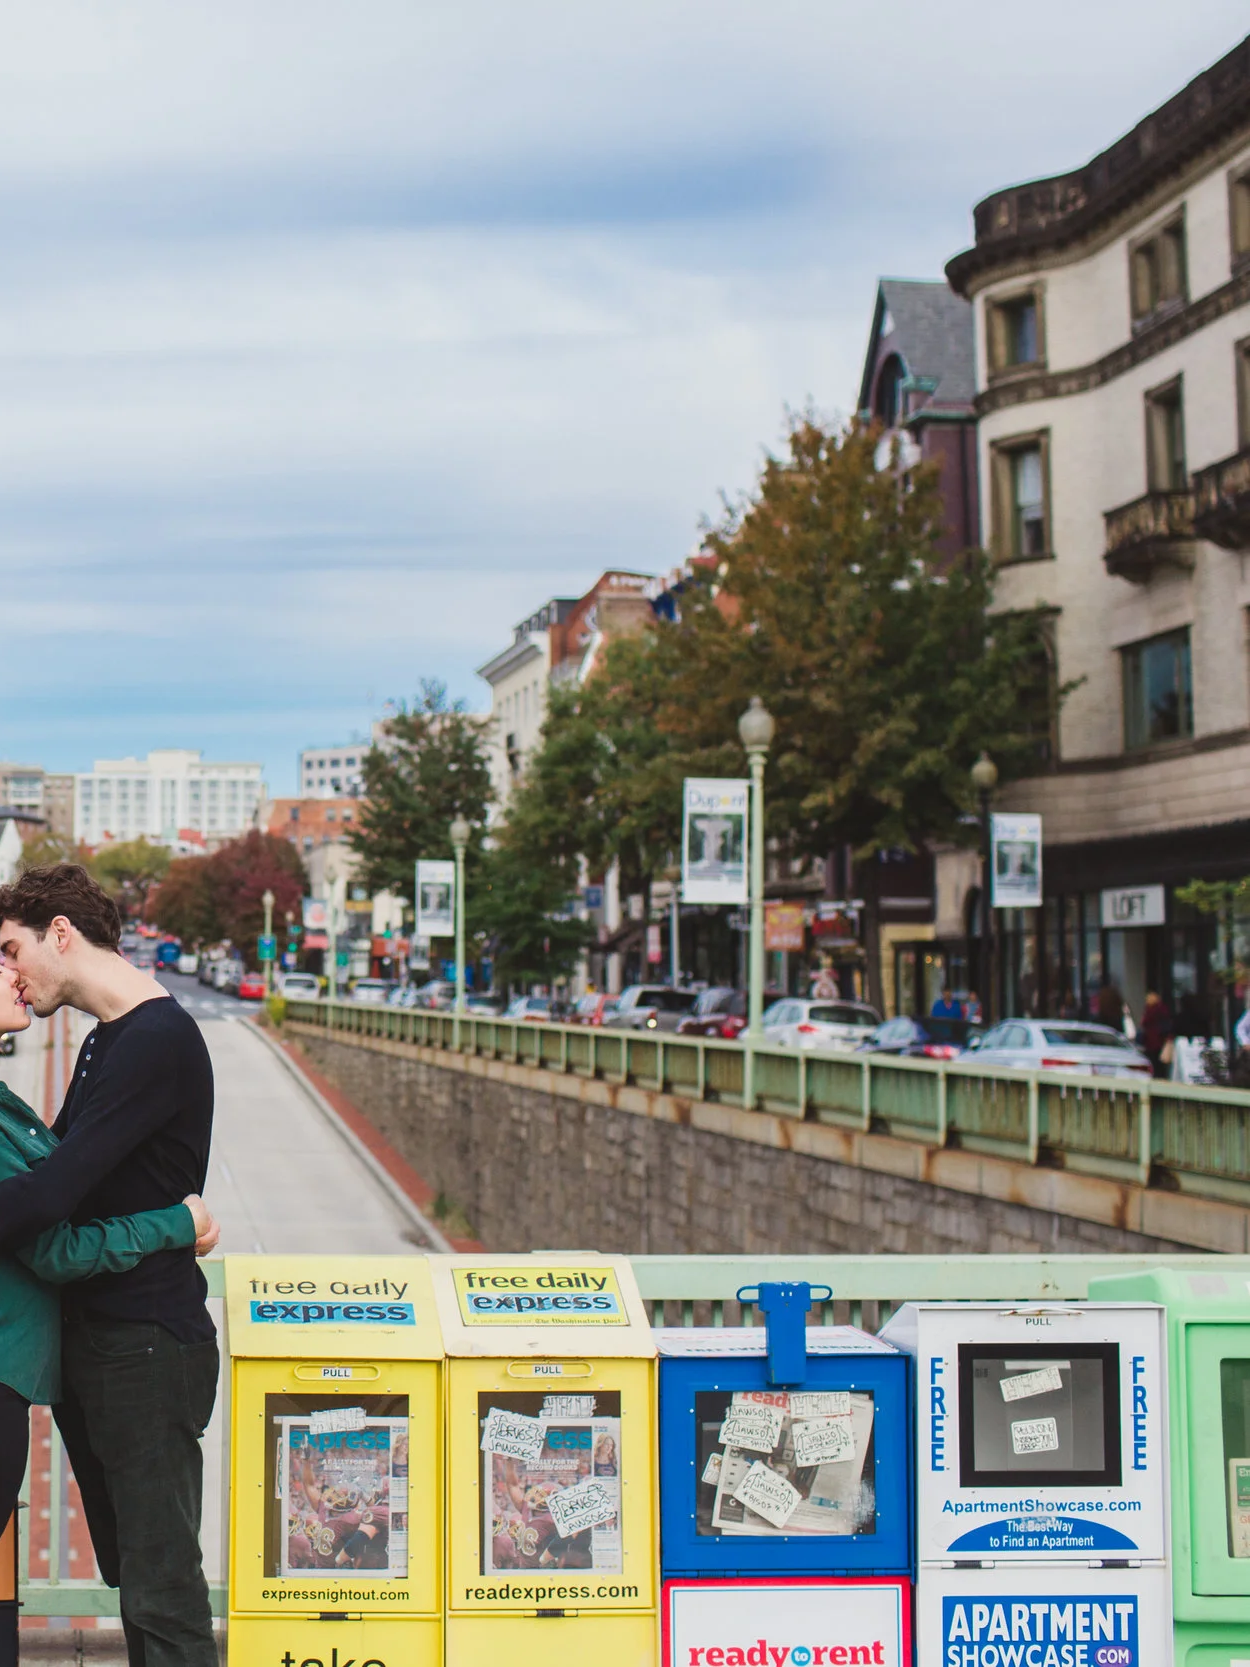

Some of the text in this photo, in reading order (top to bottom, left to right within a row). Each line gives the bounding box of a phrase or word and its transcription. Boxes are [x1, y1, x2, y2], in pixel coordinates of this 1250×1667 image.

[1112, 894, 1146, 920] LOFT
[249, 1278, 408, 1300] free daily
[464, 1272, 607, 1291] free daily
[473, 1295, 612, 1312] express
[256, 1303, 408, 1323] express
[1025, 1317, 1052, 1326] PULL
[323, 1368, 350, 1378] PULL
[534, 1366, 562, 1374] PULL
[742, 1391, 790, 1408] read
[930, 1357, 946, 1471] FREE
[1132, 1356, 1148, 1470] FREE
[290, 1431, 390, 1452] express
[942, 1499, 1142, 1515] ApartmentShowcase.com
[1006, 1520, 1074, 1534] The Best Way
[989, 1535, 1094, 1549] to Find an Apartment
[261, 1588, 410, 1603] expressnightout.com
[465, 1584, 639, 1602] readexpress.com
[948, 1603, 1134, 1642] APARTMENT
[688, 1639, 885, 1667] ready to rent
